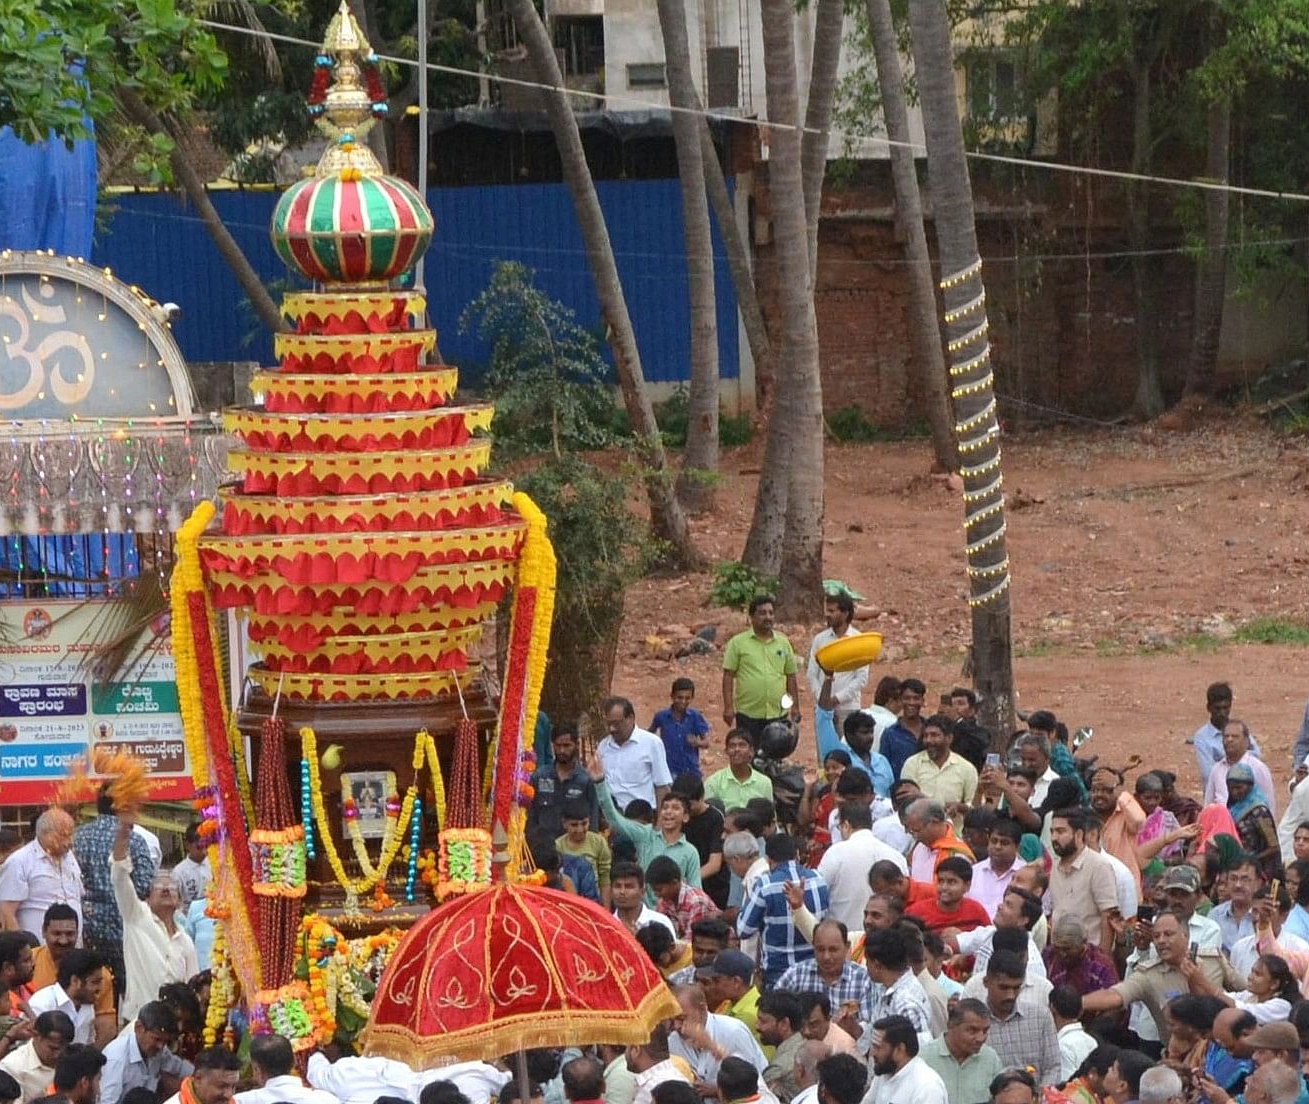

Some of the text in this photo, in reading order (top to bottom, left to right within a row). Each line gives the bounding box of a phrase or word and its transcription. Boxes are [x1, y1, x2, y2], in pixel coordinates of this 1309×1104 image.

[4, 686, 78, 702] ಶ್ರಾವಣ ಮಾಸ
[19, 700, 65, 715] ಪ್ರಾರಂಭ
[1, 754, 38, 769] ನಾಗರ
